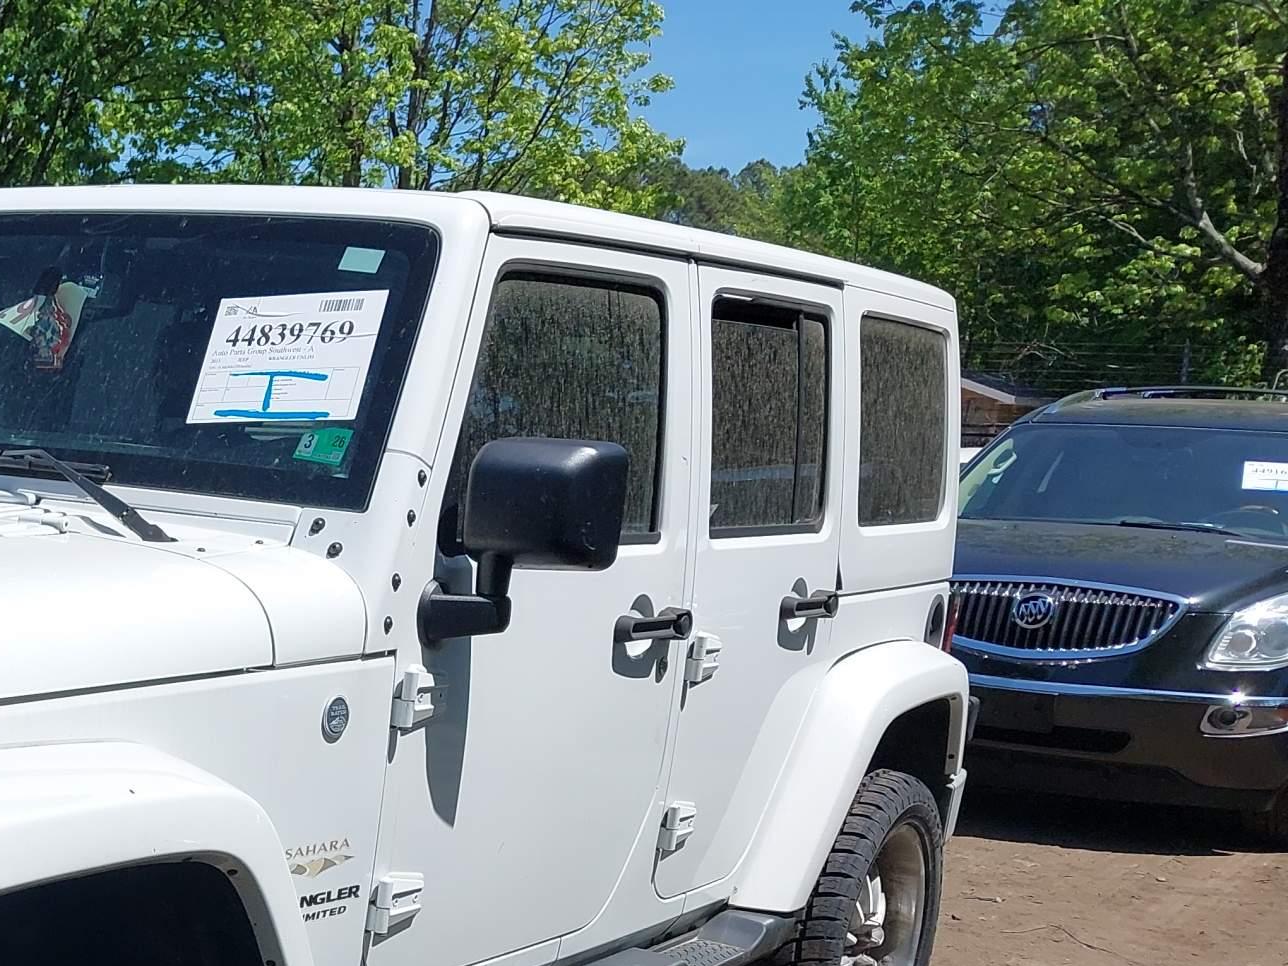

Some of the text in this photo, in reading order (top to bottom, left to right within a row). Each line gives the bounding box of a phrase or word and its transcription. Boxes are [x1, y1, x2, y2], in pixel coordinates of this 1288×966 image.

[225, 320, 355, 348] 44839769
[304, 433, 347, 449] 3 26
[285, 837, 350, 861] SAHARA
